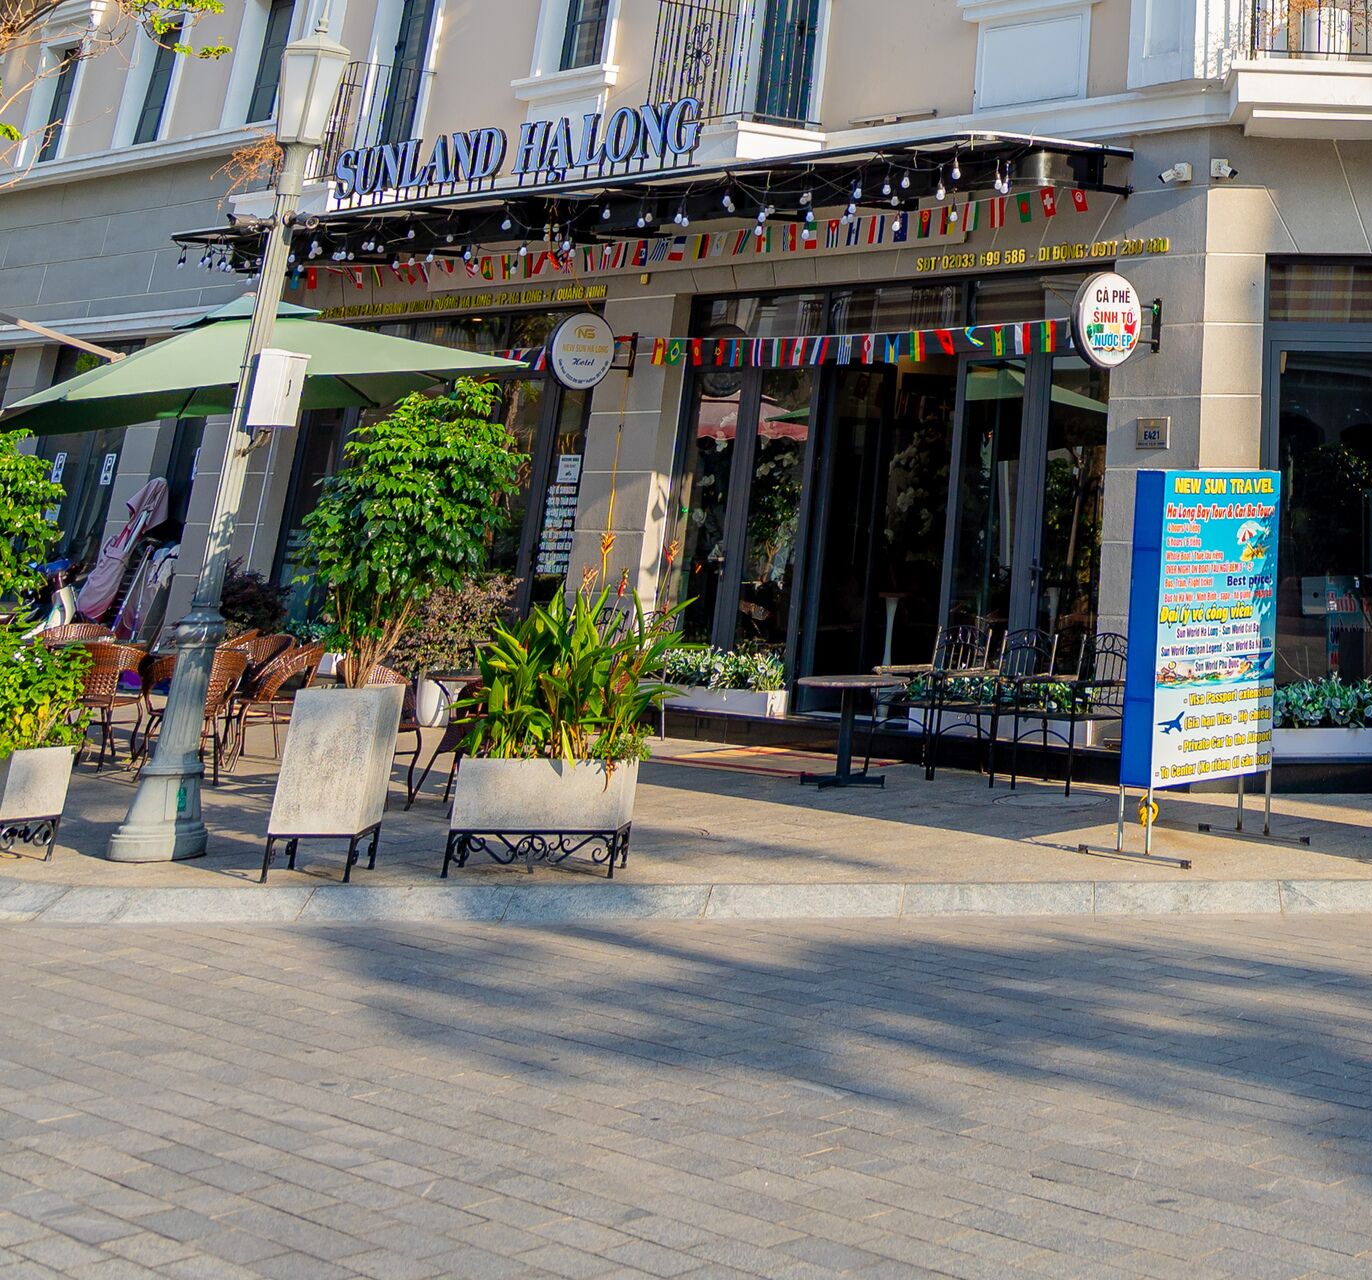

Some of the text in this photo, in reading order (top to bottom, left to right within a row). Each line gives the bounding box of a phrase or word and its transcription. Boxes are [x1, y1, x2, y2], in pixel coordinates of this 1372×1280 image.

[333, 96, 703, 200] SUNLAND HẠ LONG
[941, 253, 976, 270] 02033
[979, 250, 1001, 266] 699
[1004, 248, 1026, 264] 586
[1038, 245, 1050, 262] DI
[1090, 240, 1118, 257] 0911
[585, 285, 608, 298] NINH
[1093, 311, 1118, 324] SINH
[1174, 477, 1274, 494] NEW SUN TRAVEL
[1166, 503, 1177, 518] Ha
[1178, 503, 1195, 522] Long
[1196, 503, 1211, 522] Bay
[1212, 503, 1226, 518] Tour
[1227, 503, 1233, 518] &
[1226, 574, 1272, 589] Best price!
[1160, 604, 1179, 628] Đại
[1180, 603, 1191, 625] lý
[1205, 601, 1229, 624] công
[1176, 628, 1186, 638] Sun
[1187, 627, 1200, 638] World
[1207, 626, 1219, 638] Long
[1222, 625, 1231, 635] Sun
[1232, 623, 1245, 635] World
[1161, 646, 1170, 657] Sun
[1171, 645, 1184, 656] World
[1206, 643, 1223, 655] Legend
[1226, 642, 1235, 652] Sun
[1235, 640, 1248, 651] World
[1195, 661, 1204, 672] Sun
[1205, 660, 1218, 671] World
[1189, 685, 1273, 706] Visa Passport extension
[1183, 716, 1200, 731] (Gia
[1217, 712, 1232, 726] Visa
[1183, 729, 1272, 753] Private Car to the Airport
[1160, 765, 1169, 780] To
[1170, 763, 1196, 777] Center
